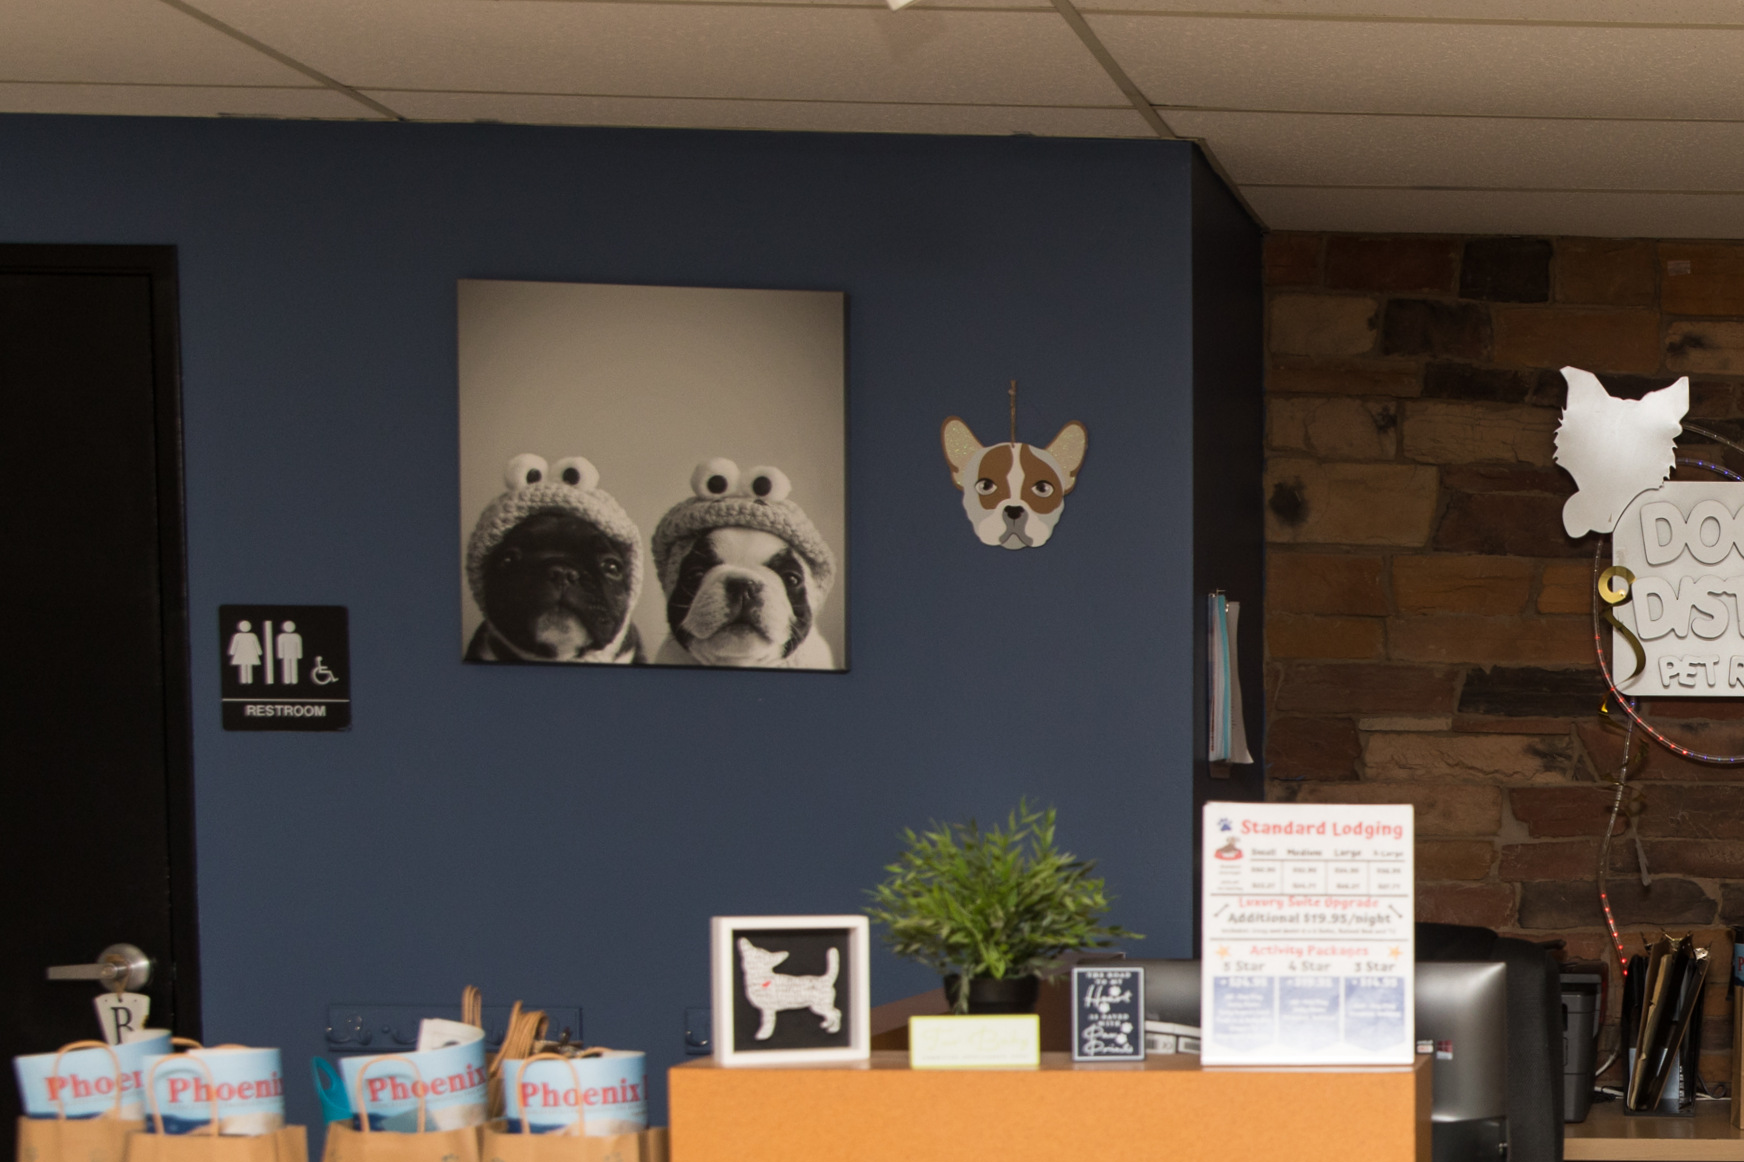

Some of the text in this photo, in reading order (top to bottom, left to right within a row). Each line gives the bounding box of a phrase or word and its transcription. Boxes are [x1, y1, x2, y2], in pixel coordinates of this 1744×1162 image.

[1658, 655, 1720, 688] PET
[245, 704, 326, 716] RESTROOM
[1241, 820, 1404, 839] Standard Lodging
[1228, 913, 1299, 924] Additional
[168, 1072, 284, 1104] Phoeni
[366, 1064, 487, 1102] Phoenix
[521, 1078, 640, 1108] Phoenix
